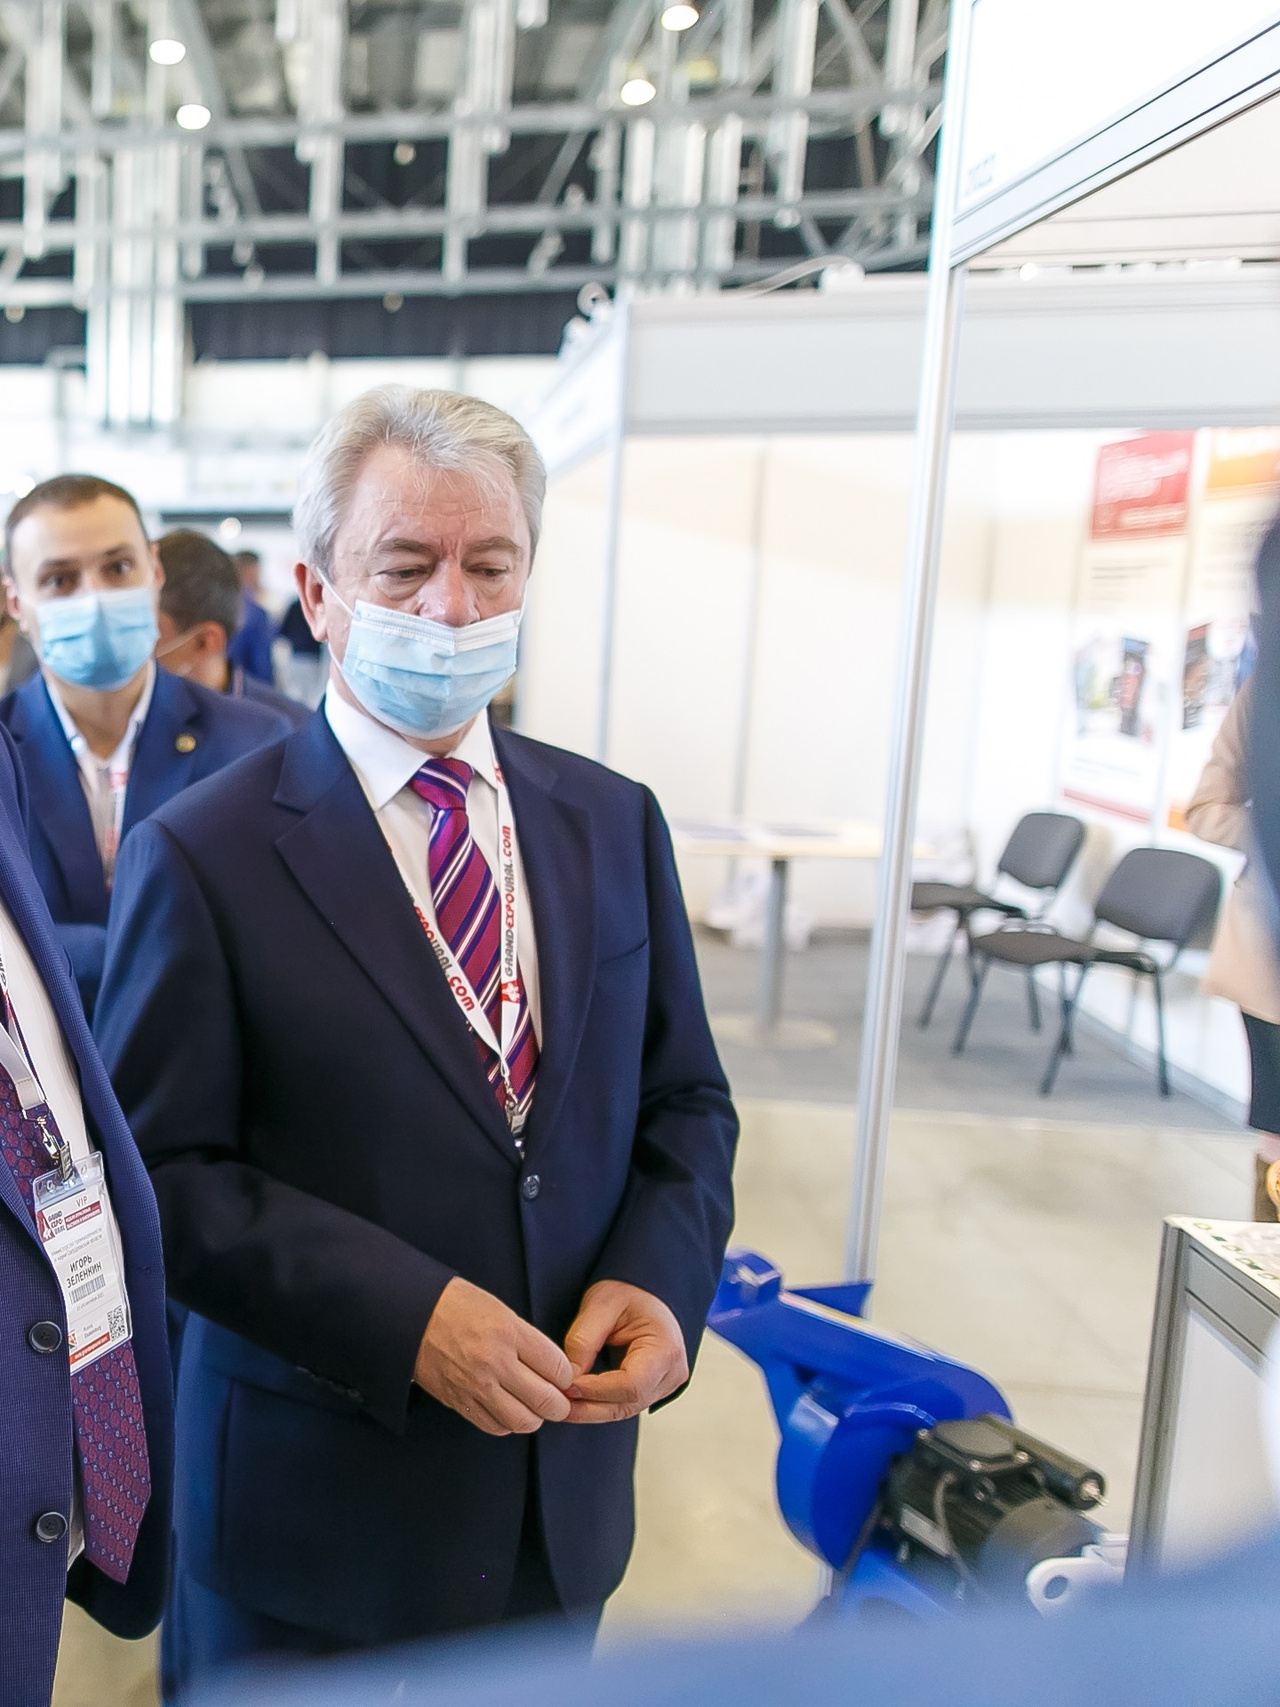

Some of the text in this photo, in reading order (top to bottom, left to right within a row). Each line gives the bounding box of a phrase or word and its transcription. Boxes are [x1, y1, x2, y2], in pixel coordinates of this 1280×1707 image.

[76, 1195, 88, 1207] VIP
[69, 1254, 93, 1273] ИГОРЬ
[66, 1261, 102, 1289] ЗЕЛЕНКИН
